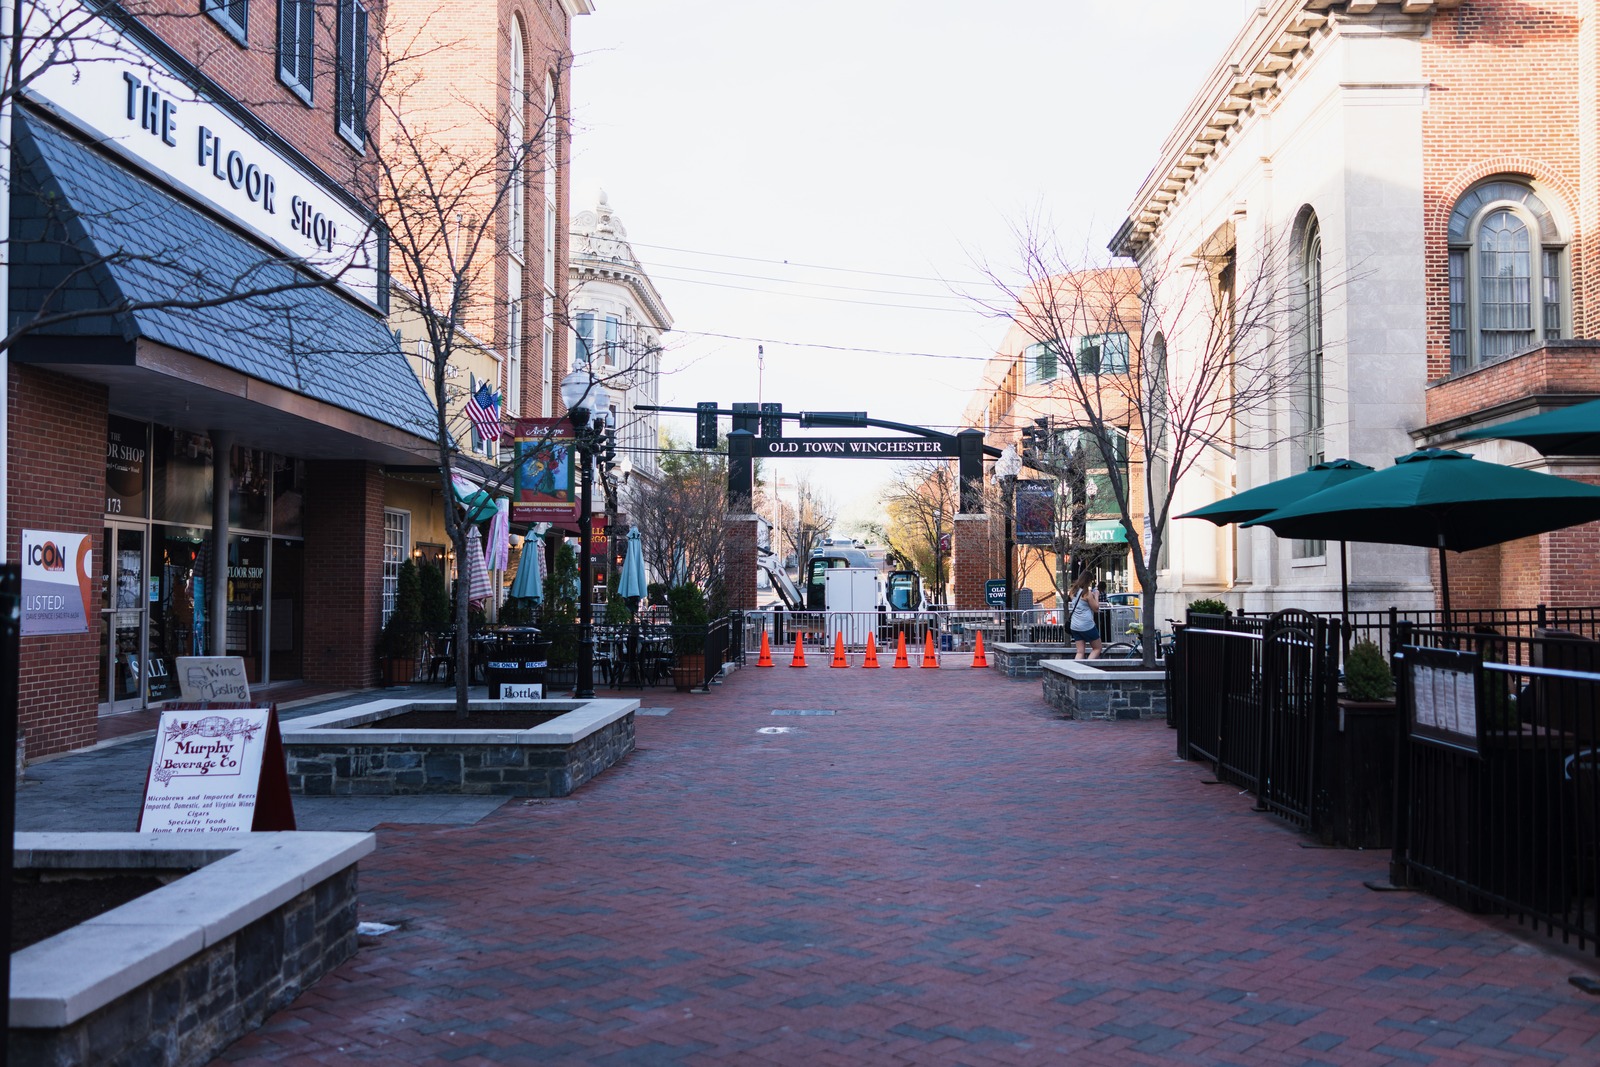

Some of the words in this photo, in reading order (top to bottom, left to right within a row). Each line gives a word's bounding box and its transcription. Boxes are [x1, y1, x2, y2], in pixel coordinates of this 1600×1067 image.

[123, 71, 177, 147] THE
[198, 126, 276, 214] FLOOR
[291, 195, 337, 253] SHOP
[110, 432, 121, 441] THE
[769, 442, 799, 453] OLD
[803, 442, 845, 453] TOWN
[849, 441, 943, 453] WINCHESTER
[120, 445, 145, 463] SHOP
[107, 497, 121, 513] 173
[28, 544, 65, 571] ICON
[248, 568, 263, 578] SHOP
[26, 595, 65, 611] LISTED!
[206, 664, 241, 678] Wine
[205, 679, 247, 700] Tasting
[504, 686, 540, 699] Bottles
[174, 741, 235, 760] Murphy
[163, 759, 217, 774] Beverage
[219, 757, 237, 769] Co
[203, 793, 234, 801] Imported
[215, 801, 236, 810] Virginia
[187, 810, 210, 818] Cigars
[168, 819, 201, 827] Specialty
[209, 826, 240, 834] Supplies
